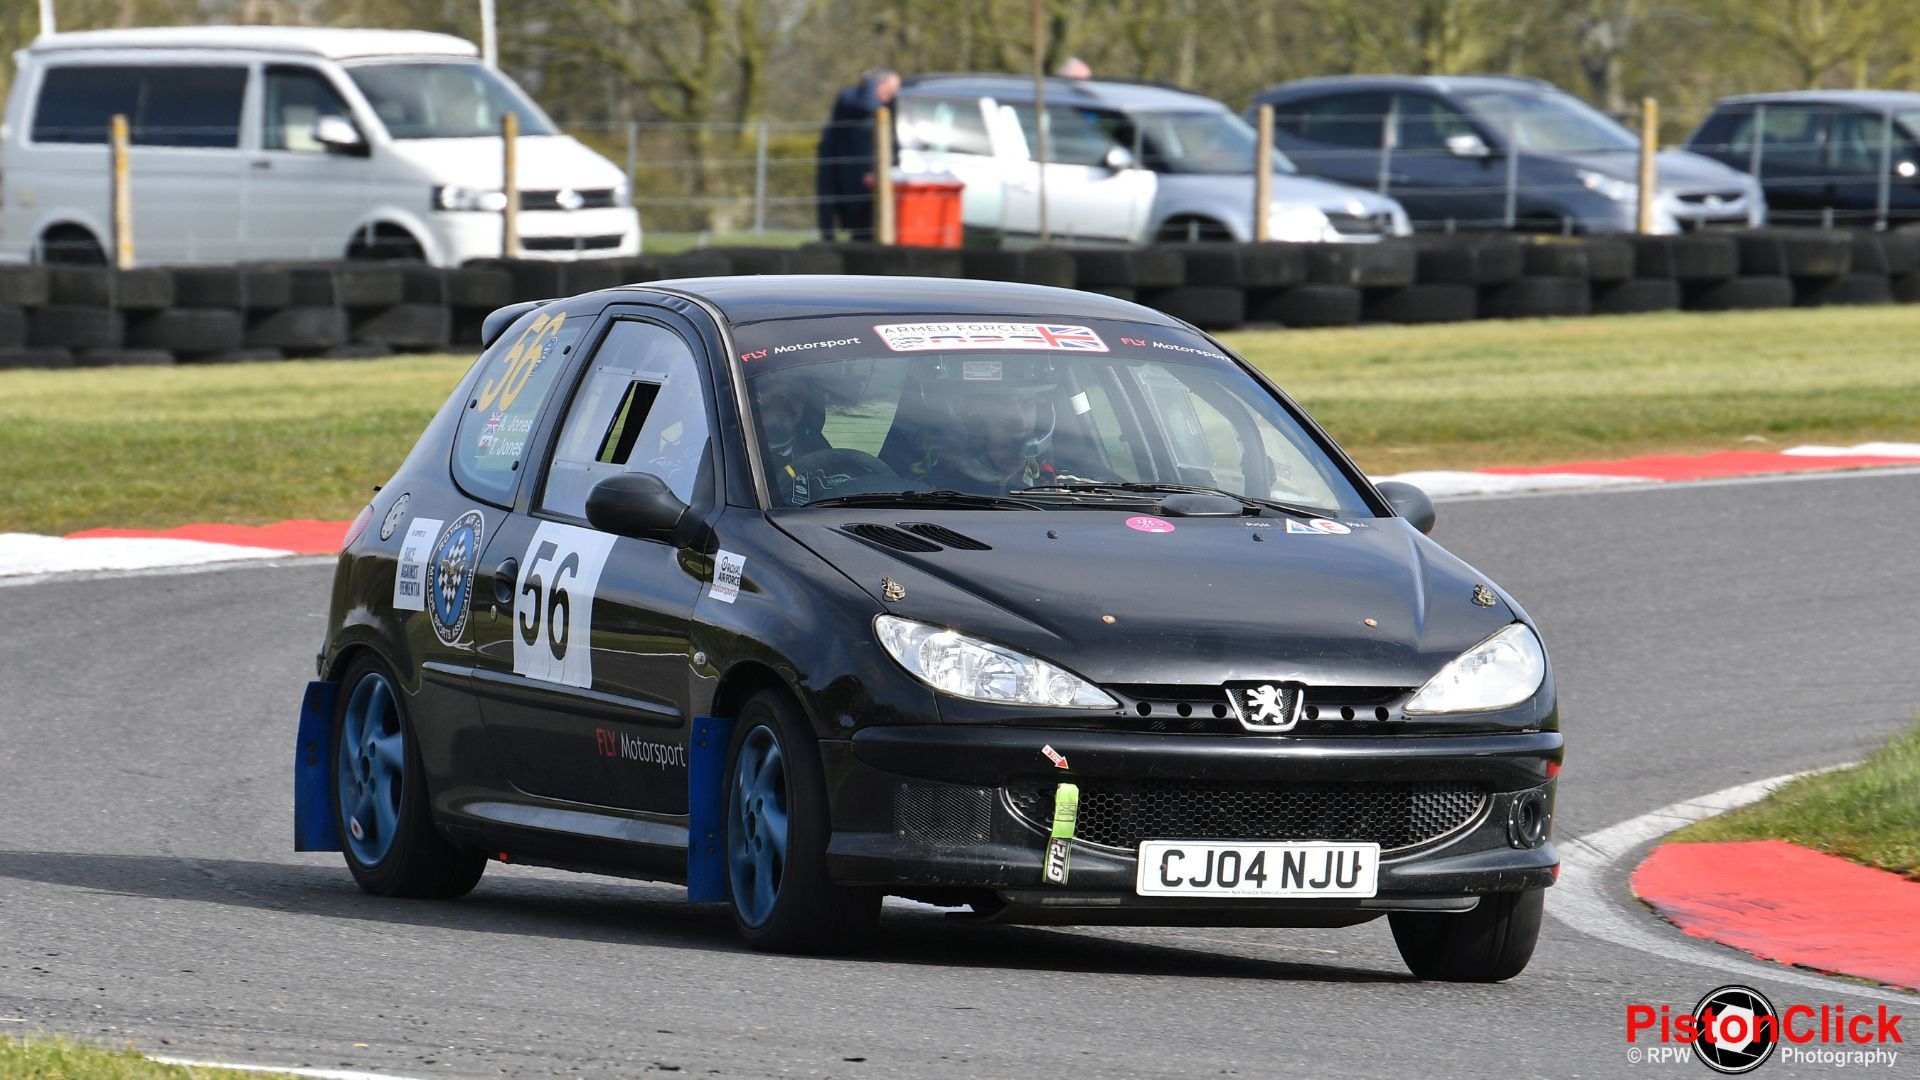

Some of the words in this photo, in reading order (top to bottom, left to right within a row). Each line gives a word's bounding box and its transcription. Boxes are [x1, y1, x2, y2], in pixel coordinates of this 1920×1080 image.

[884, 325, 949, 333] ARMED
[956, 324, 1034, 333] FORCES
[741, 349, 768, 362] FLY
[774, 336, 861, 354] Motorsport
[1120, 337, 1146, 346] FLY
[478, 311, 567, 413] 56
[507, 416, 532, 433] Jones
[498, 438, 524, 456] Jones
[400, 563, 419, 579] AGAINST
[727, 562, 741, 575] ROYAL
[399, 580, 420, 597] DEMENTIA
[428, 565, 436, 612] MOTOR
[434, 613, 451, 640] SPORTS
[451, 568, 473, 639] ASSOCIATION
[519, 540, 579, 661] 56
[596, 728, 616, 757] FLY
[621, 733, 686, 771] Motorsport
[1160, 849, 1268, 889] CJ04
[1281, 849, 1361, 889] NJU
